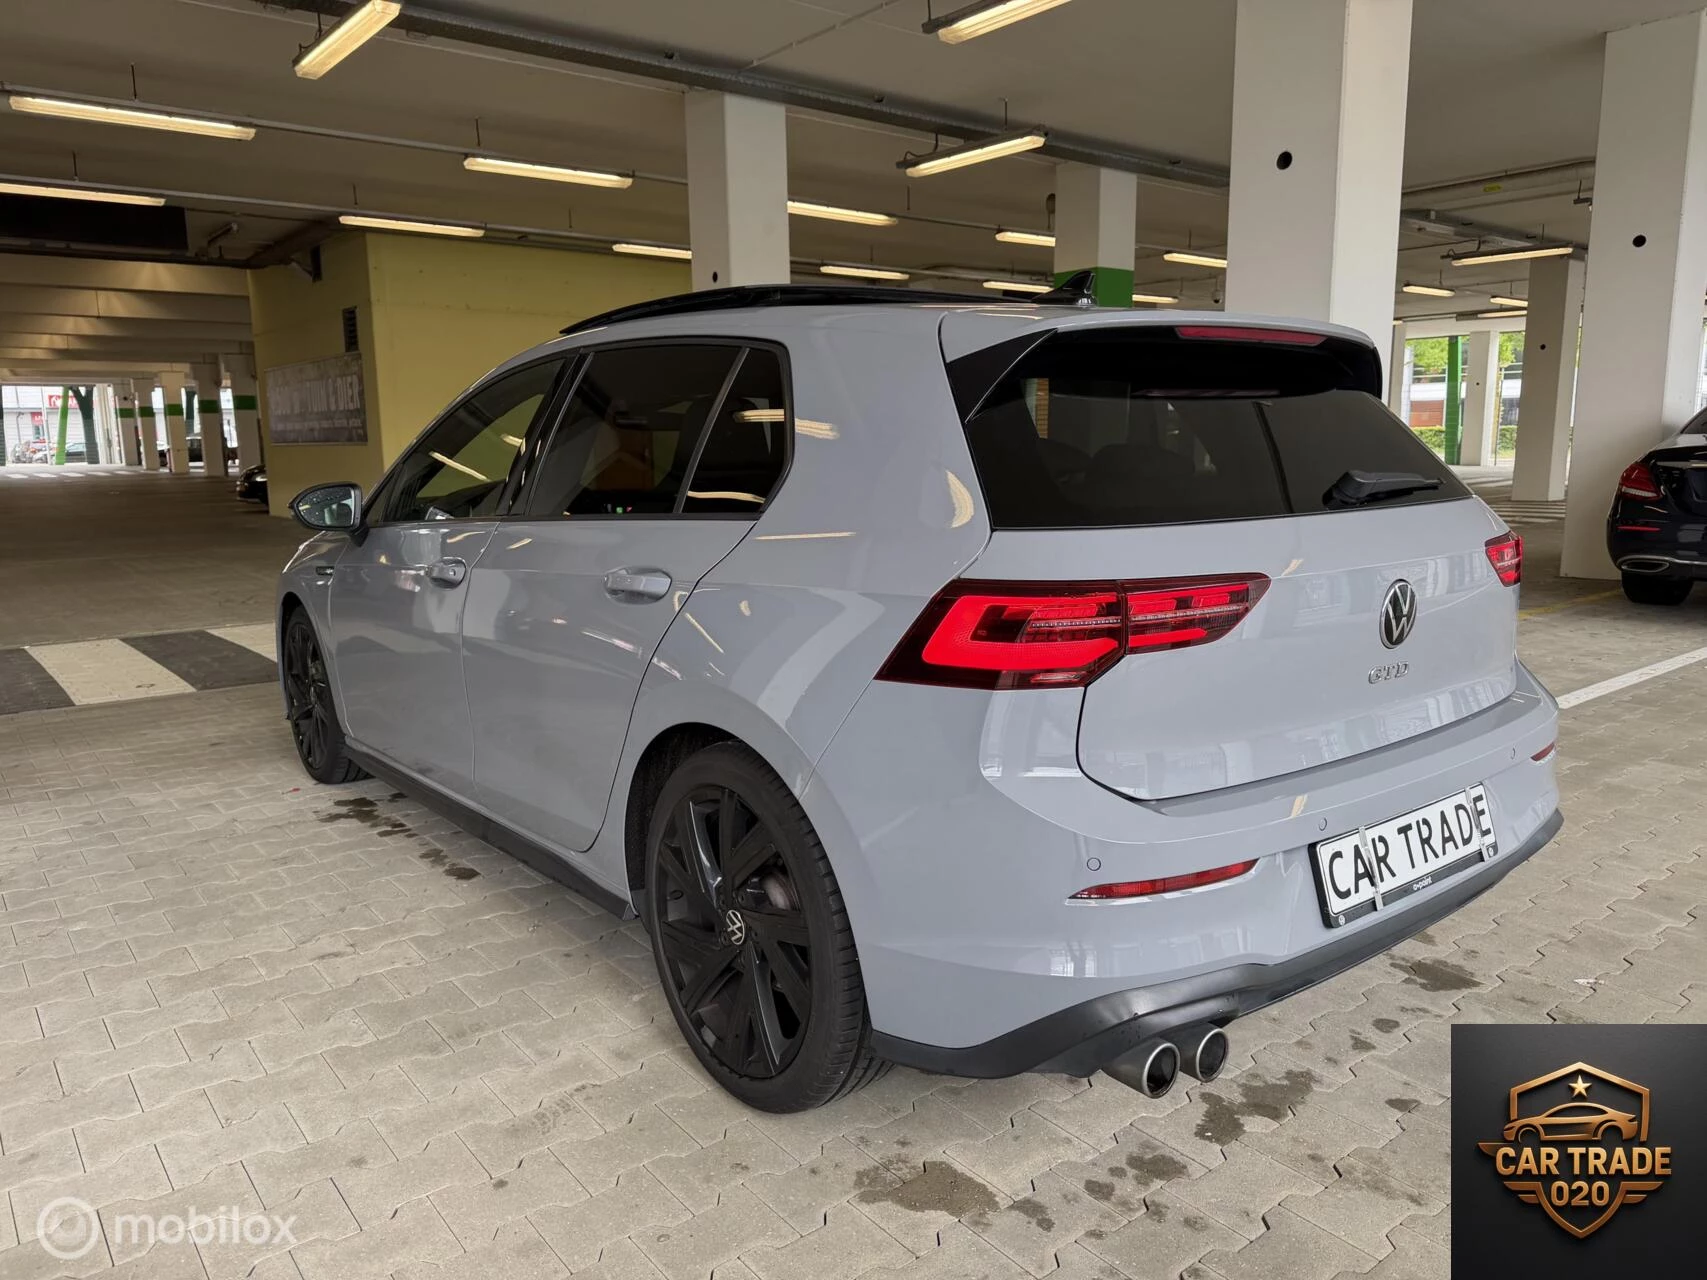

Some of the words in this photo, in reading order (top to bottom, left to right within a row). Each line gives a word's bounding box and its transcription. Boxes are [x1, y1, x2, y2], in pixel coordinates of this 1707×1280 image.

[1368, 661, 1409, 684] GTD
[1328, 834, 1397, 900] CAR
[1396, 794, 1492, 870] TRADE
